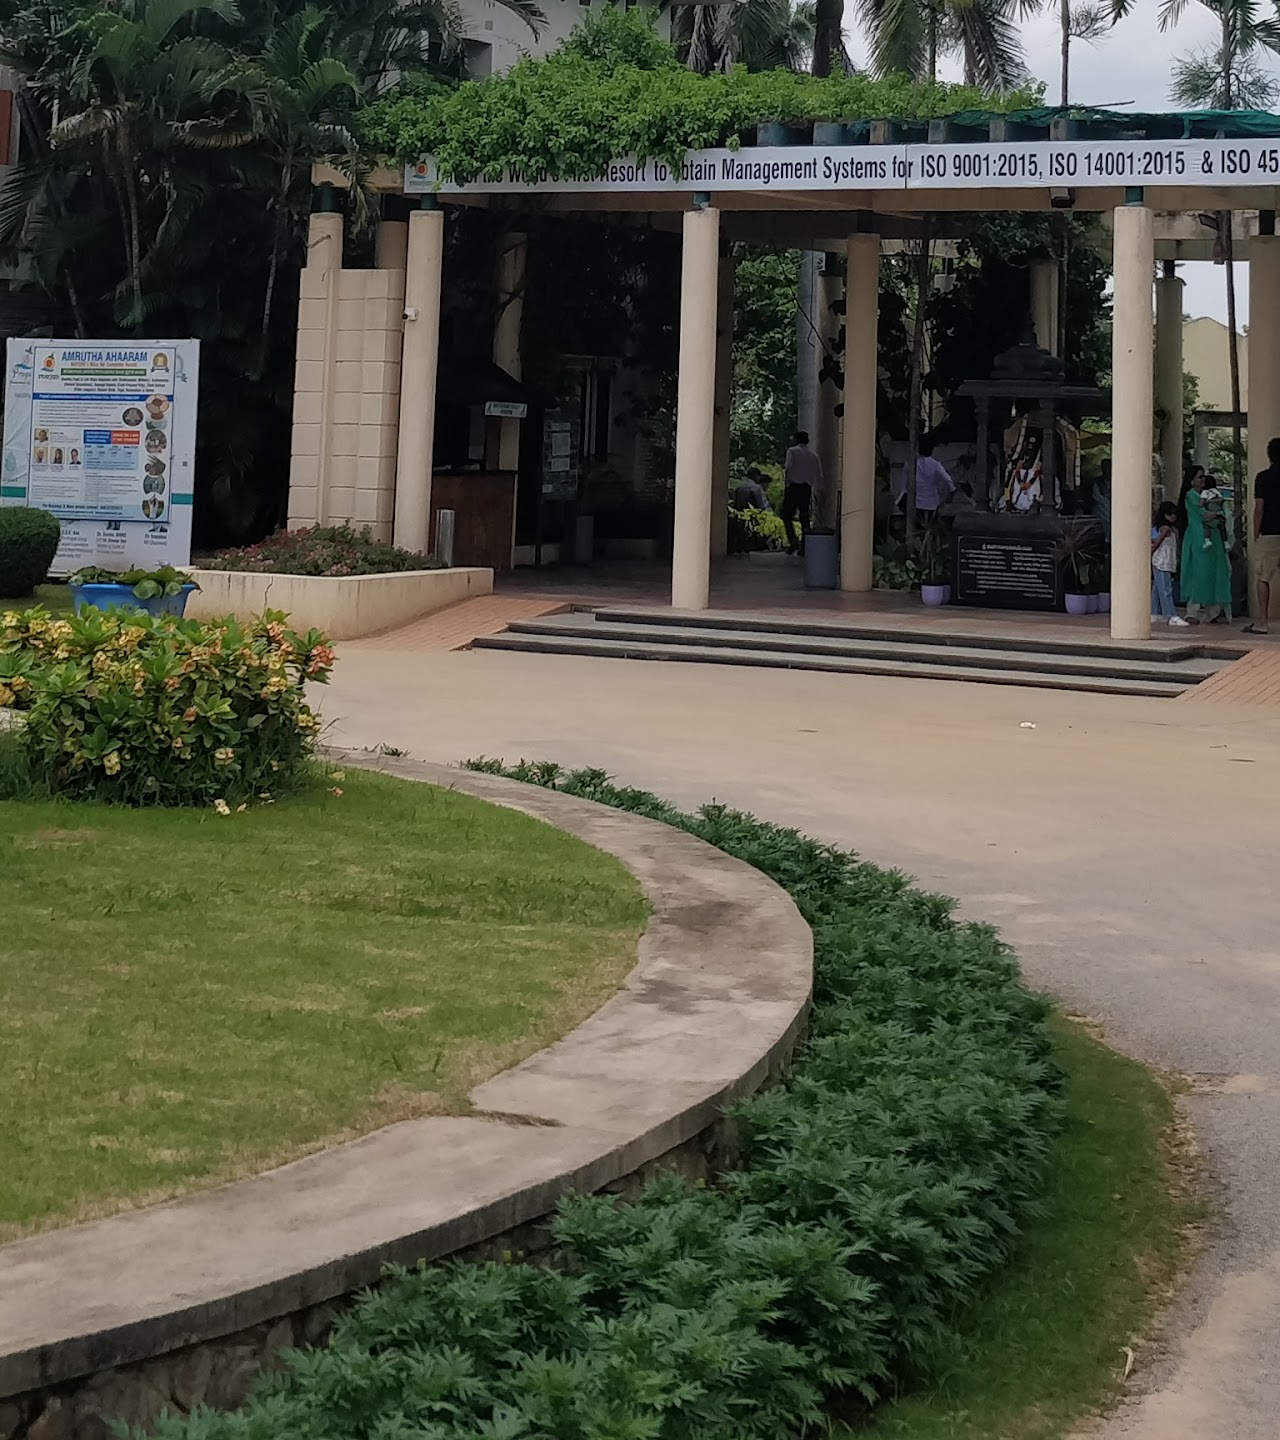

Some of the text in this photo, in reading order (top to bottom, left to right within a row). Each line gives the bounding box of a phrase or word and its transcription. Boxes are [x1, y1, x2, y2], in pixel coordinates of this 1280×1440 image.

[600, 162, 646, 182] Resort
[654, 160, 667, 182] to
[671, 158, 716, 182] btain
[722, 158, 818, 184] Management
[823, 156, 887, 184] Systems
[892, 155, 914, 178] for
[921, 154, 947, 178] ISO
[953, 153, 1043, 180] 9001:2015,
[1050, 152, 1077, 176] ISO
[1085, 151, 1186, 176] 14001:2015
[1201, 150, 1214, 174] &
[1221, 149, 1251, 174] ISO
[62, 351, 148, 362] AMRUTHA AHAARAM
